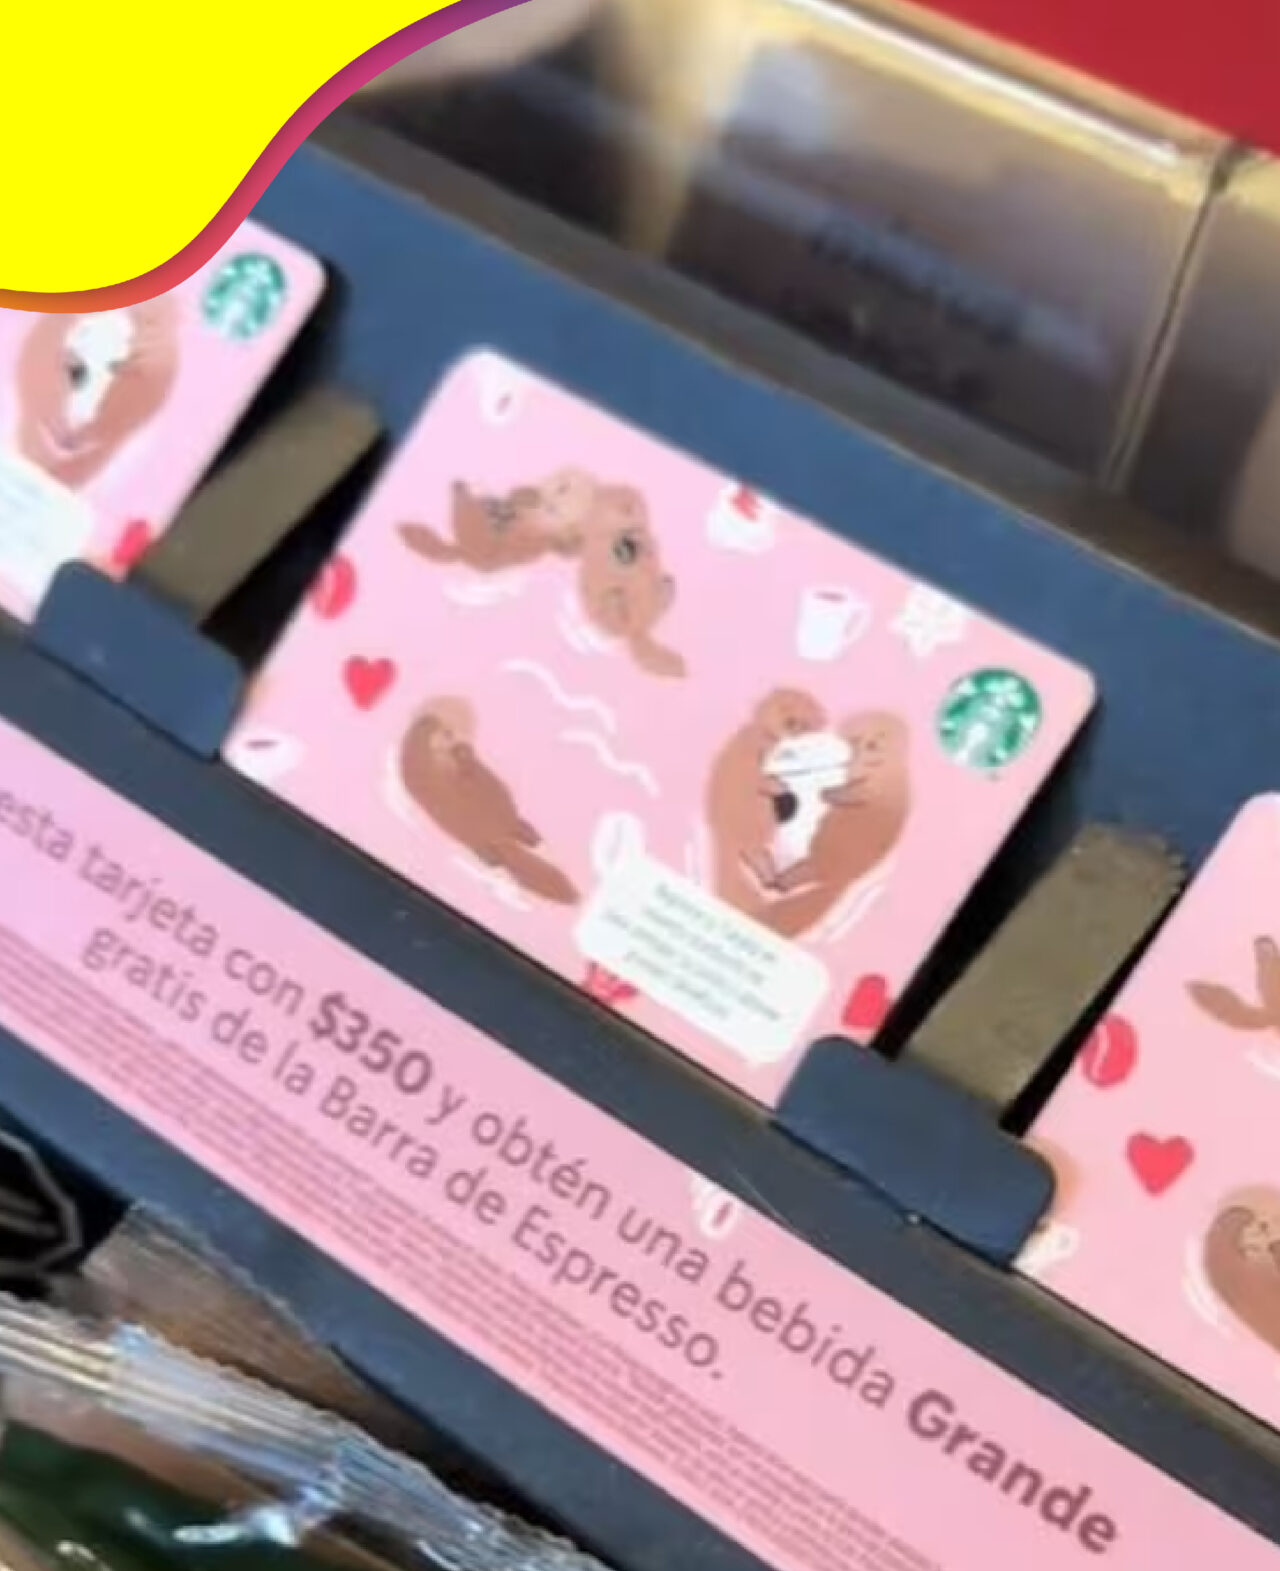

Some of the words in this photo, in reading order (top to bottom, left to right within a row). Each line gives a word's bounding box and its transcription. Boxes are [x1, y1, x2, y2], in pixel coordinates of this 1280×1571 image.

[0, 789, 74, 863] esta
[78, 845, 219, 958] tarjeta
[224, 941, 304, 1017] con
[307, 992, 433, 1095] $350
[425, 1082, 466, 1125] y
[471, 1111, 613, 1220] obtén
[617, 1205, 710, 1284] una
[715, 1259, 895, 1408] bebida
[906, 1388, 1119, 1556] Grande
[81, 926, 207, 1023] gratis
[210, 1008, 268, 1065] de
[274, 1038, 315, 1095] la
[318, 1074, 437, 1180] Barra
[444, 1166, 507, 1225] de
[511, 1204, 724, 1380] Espresso.
